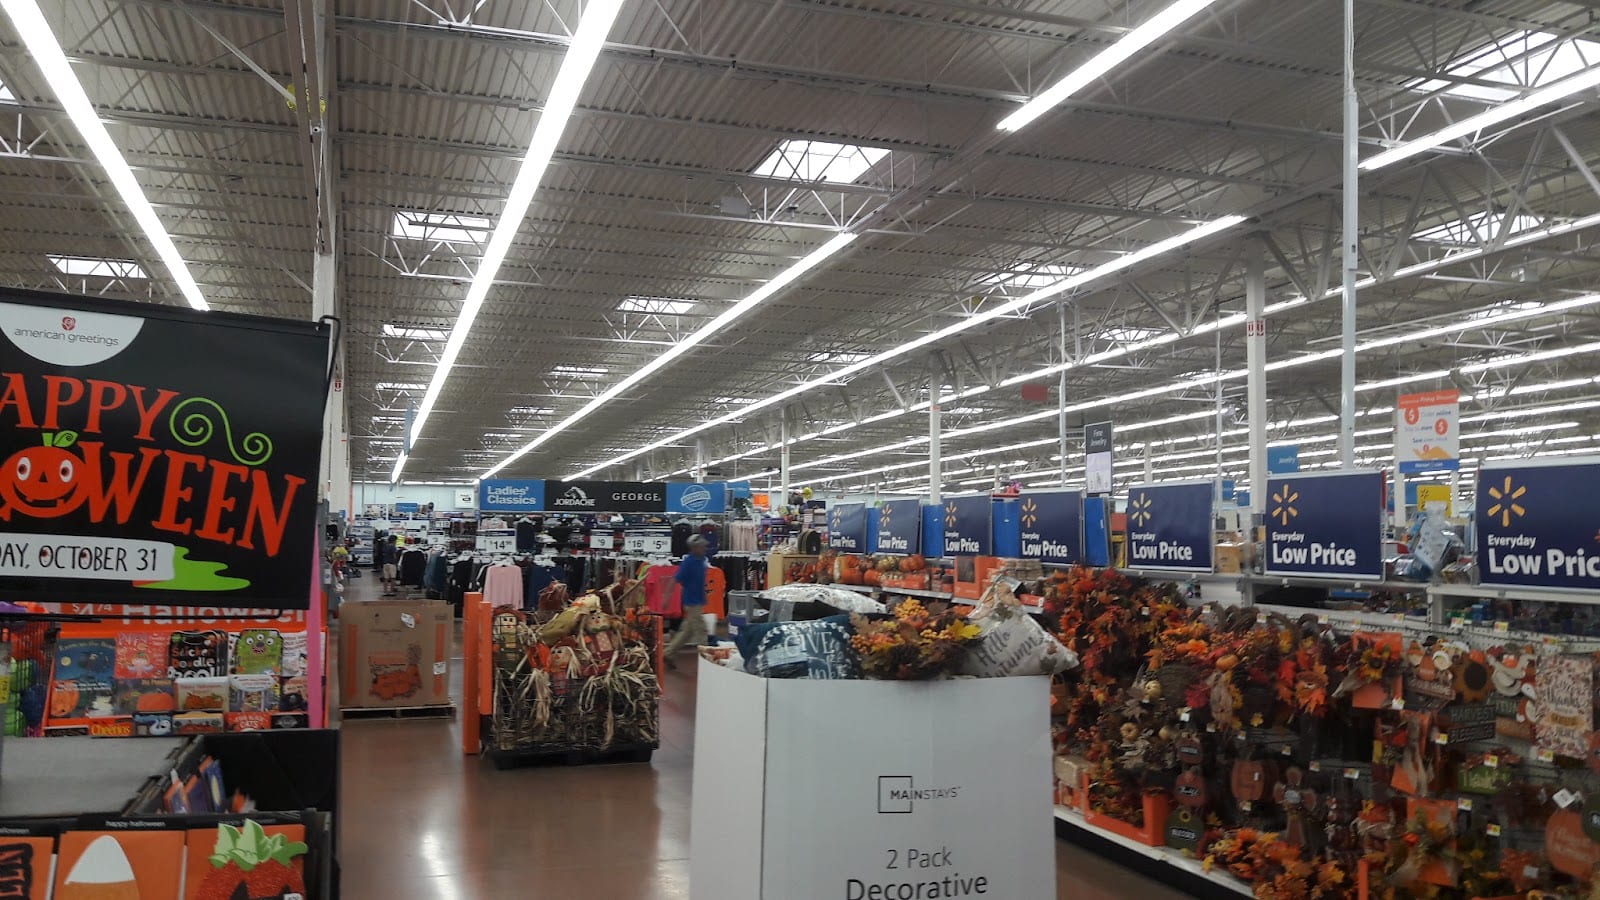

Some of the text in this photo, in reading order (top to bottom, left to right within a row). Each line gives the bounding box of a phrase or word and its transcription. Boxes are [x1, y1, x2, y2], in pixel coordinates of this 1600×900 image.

[14, 326, 119, 347] american greetings
[487, 486, 529, 495] Ladies'
[612, 492, 661, 502] GEORGE
[487, 495, 536, 504] Classics
[554, 498, 596, 506] JORDACHE
[1022, 532, 1040, 541] Everyday
[1131, 532, 1156, 542] Everyday
[1272, 532, 1304, 544] Everyday
[1487, 533, 1536, 549] Everyday
[1022, 540, 1068, 557] Low Price
[1132, 541, 1192, 562] Low Price
[1272, 542, 1357, 567] Low Price
[0, 545, 157, 576] AY, OCTOBER 31
[1488, 547, 1542, 575] Low
[1451, 705, 1496, 723] HARVEST
[890, 788, 958, 800] MAINSTAYS
[886, 846, 952, 869] 2 Pack
[847, 873, 988, 900] Decorative
